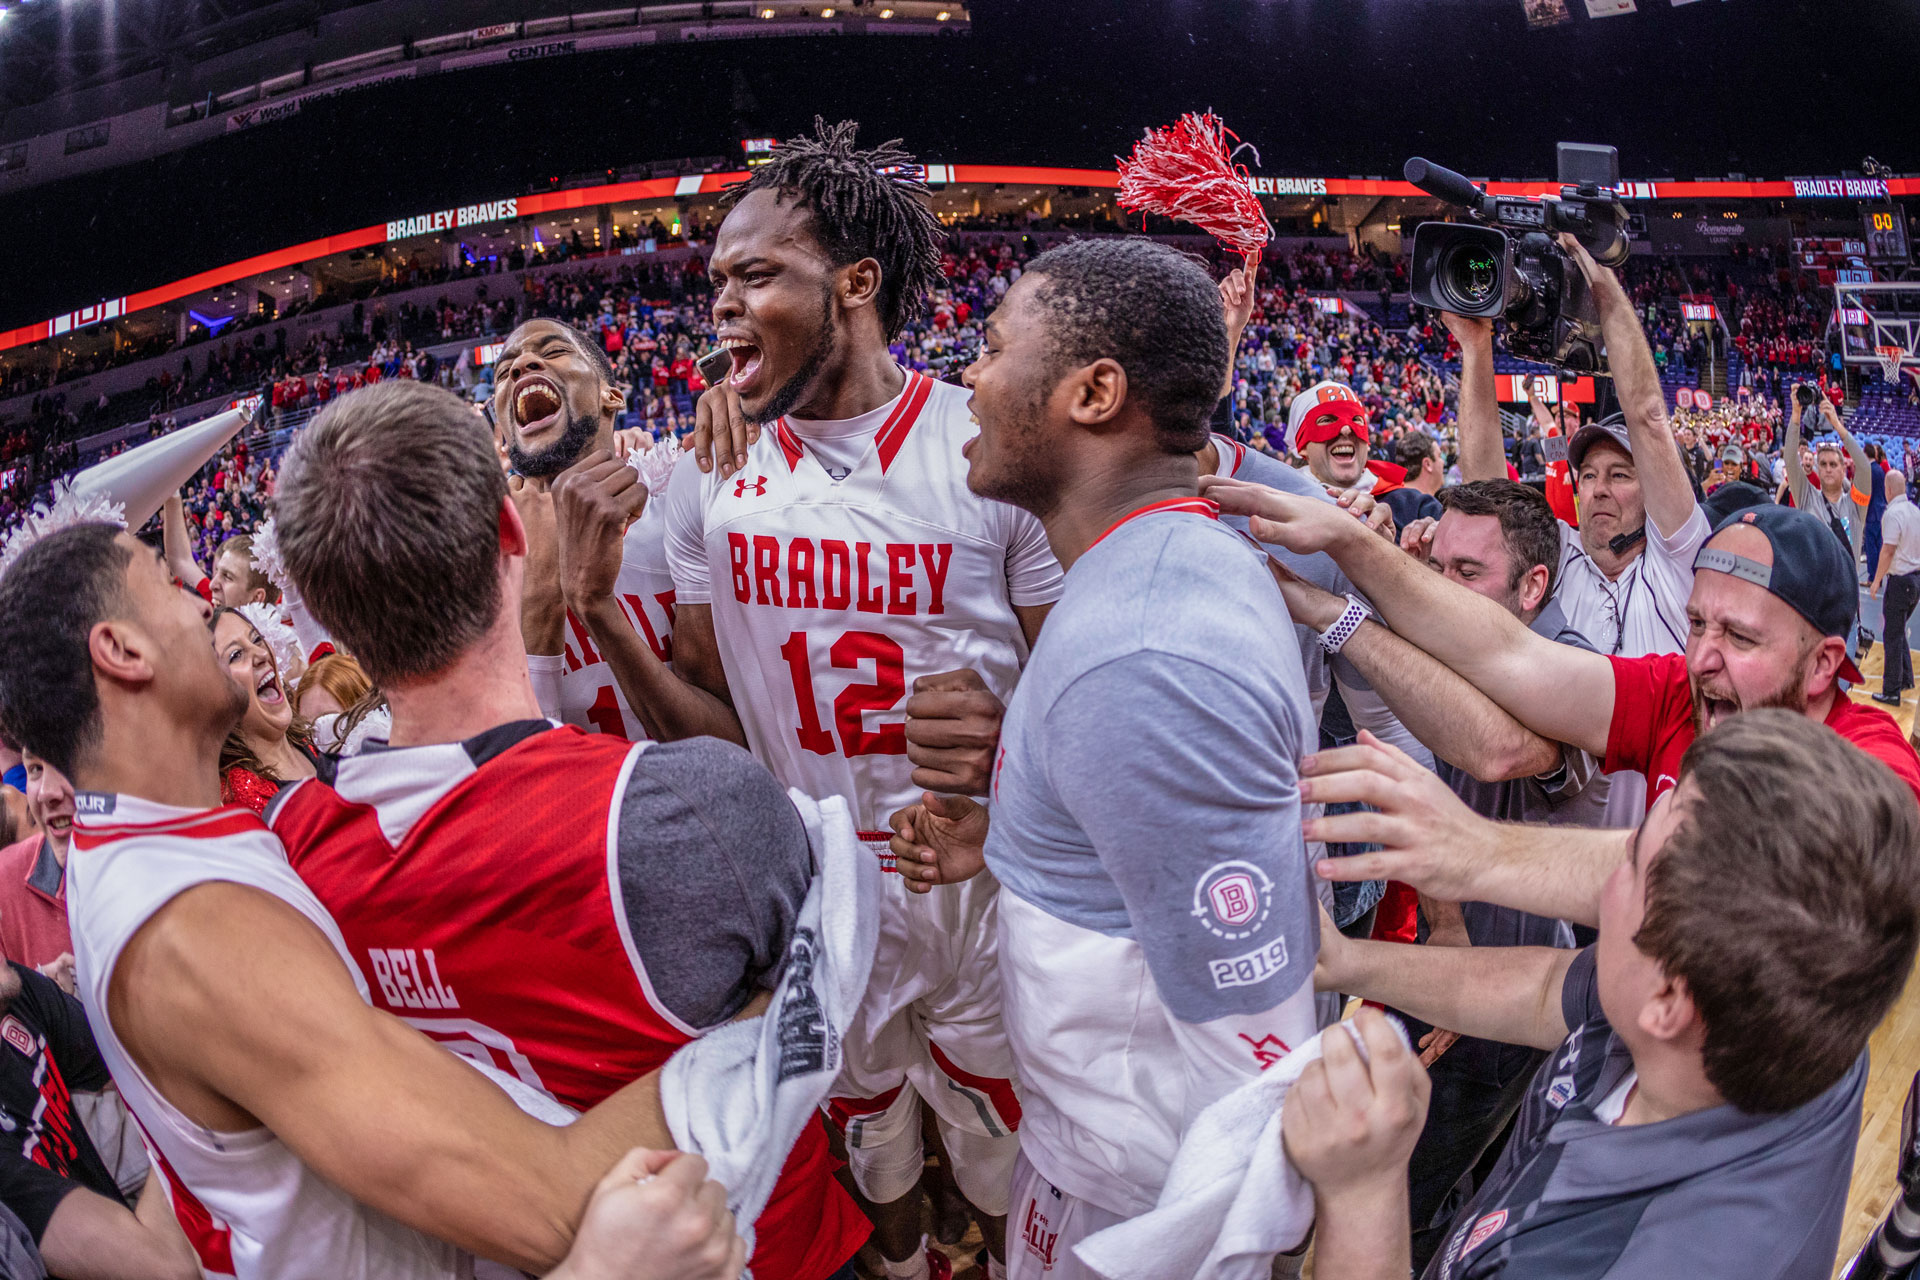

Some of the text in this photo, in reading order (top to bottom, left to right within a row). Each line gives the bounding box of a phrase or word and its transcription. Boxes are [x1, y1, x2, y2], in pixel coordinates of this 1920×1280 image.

[508, 41, 577, 60] CENTENE
[259, 103, 296, 121] World
[1277, 178, 1327, 195] BRAVES
[1794, 180, 1842, 198] BRADLEY
[387, 199, 517, 242] BRADLEY BRAVES
[728, 532, 953, 616] BRADLEY
[780, 631, 908, 758] 12
[368, 948, 460, 1009] BELL
[1214, 941, 1286, 985] 2019
[1033, 1210, 1050, 1227] THE
